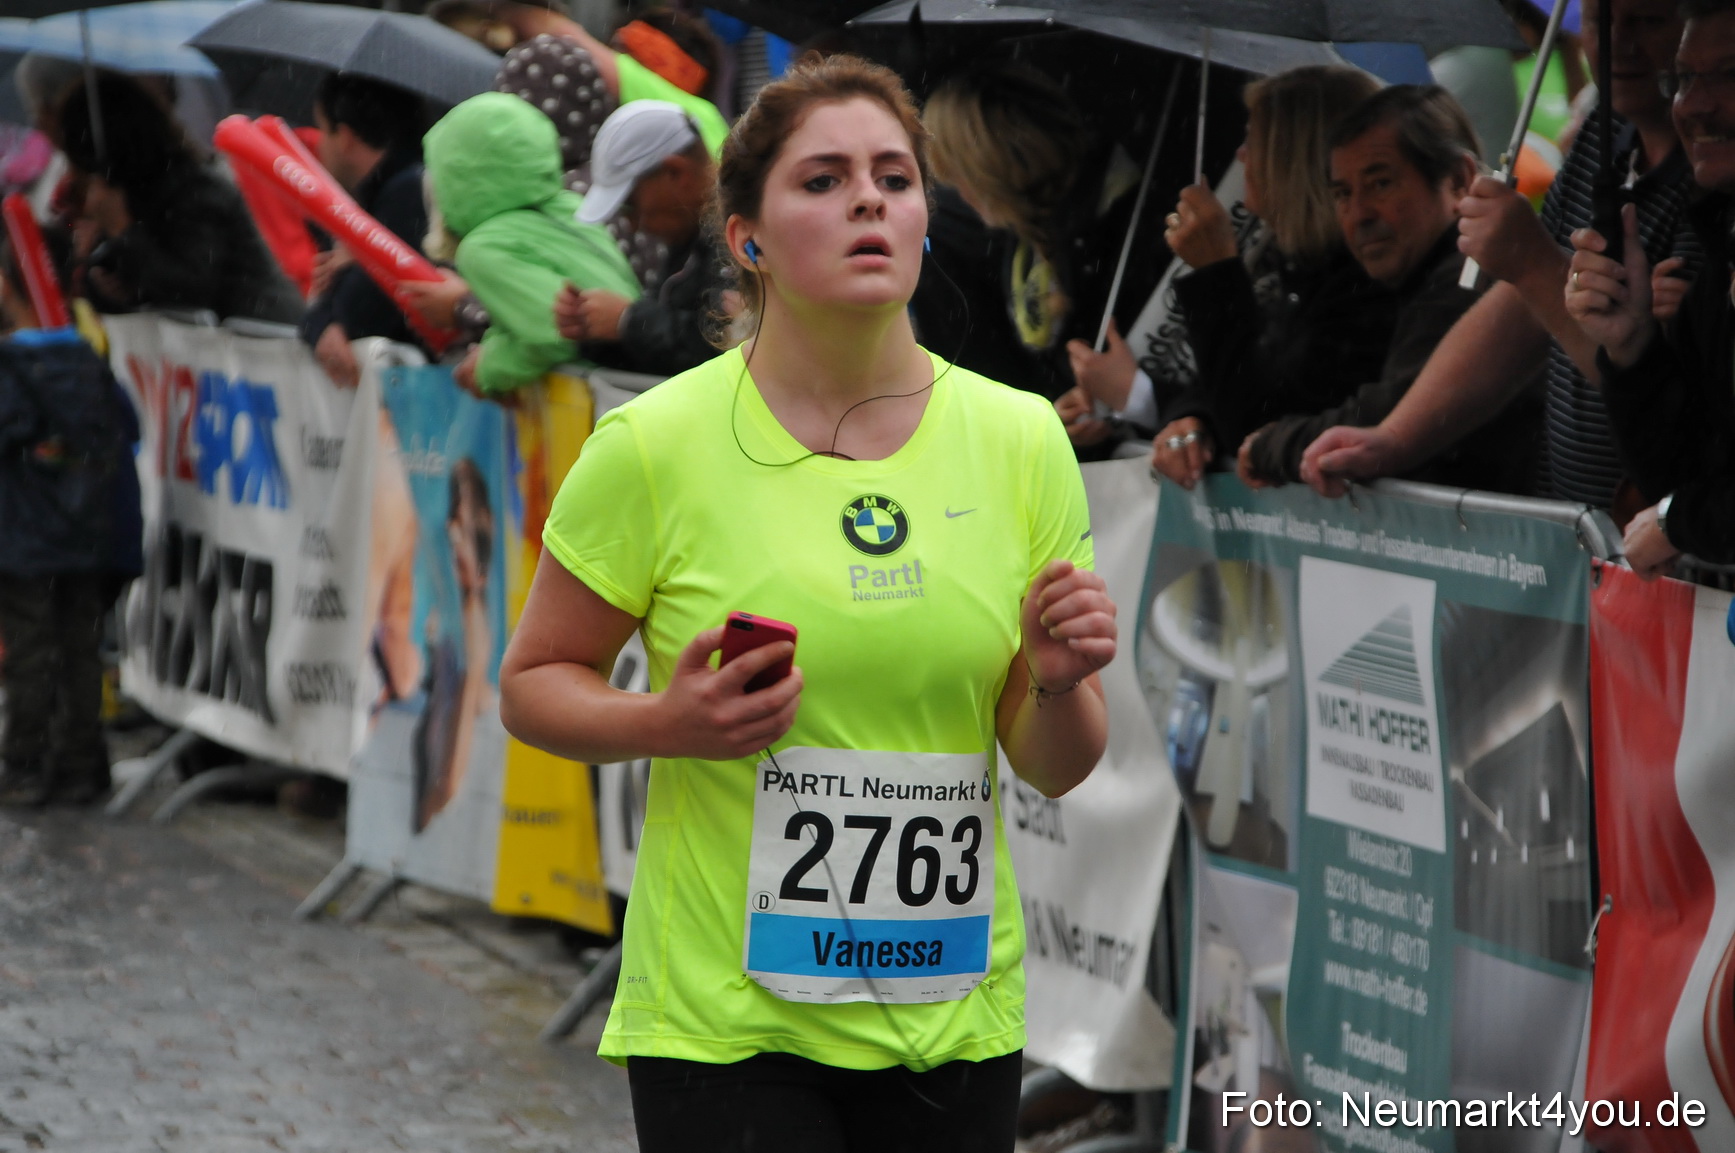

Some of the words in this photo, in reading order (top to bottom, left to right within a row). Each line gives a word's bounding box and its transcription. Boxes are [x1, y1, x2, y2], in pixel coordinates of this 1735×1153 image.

[844, 496, 900, 519] BMW
[849, 560, 923, 589] Partl
[1508, 553, 1547, 591] Bayern
[852, 586, 925, 602] Neumarkt
[1368, 705, 1432, 755] HOFFER
[763, 770, 854, 797] PARTL
[862, 777, 977, 801] Neumarkt
[779, 810, 982, 907] 2763
[758, 894, 769, 910] D
[812, 931, 943, 968] Vanessa
[1341, 1020, 1408, 1074] Trockenbau
